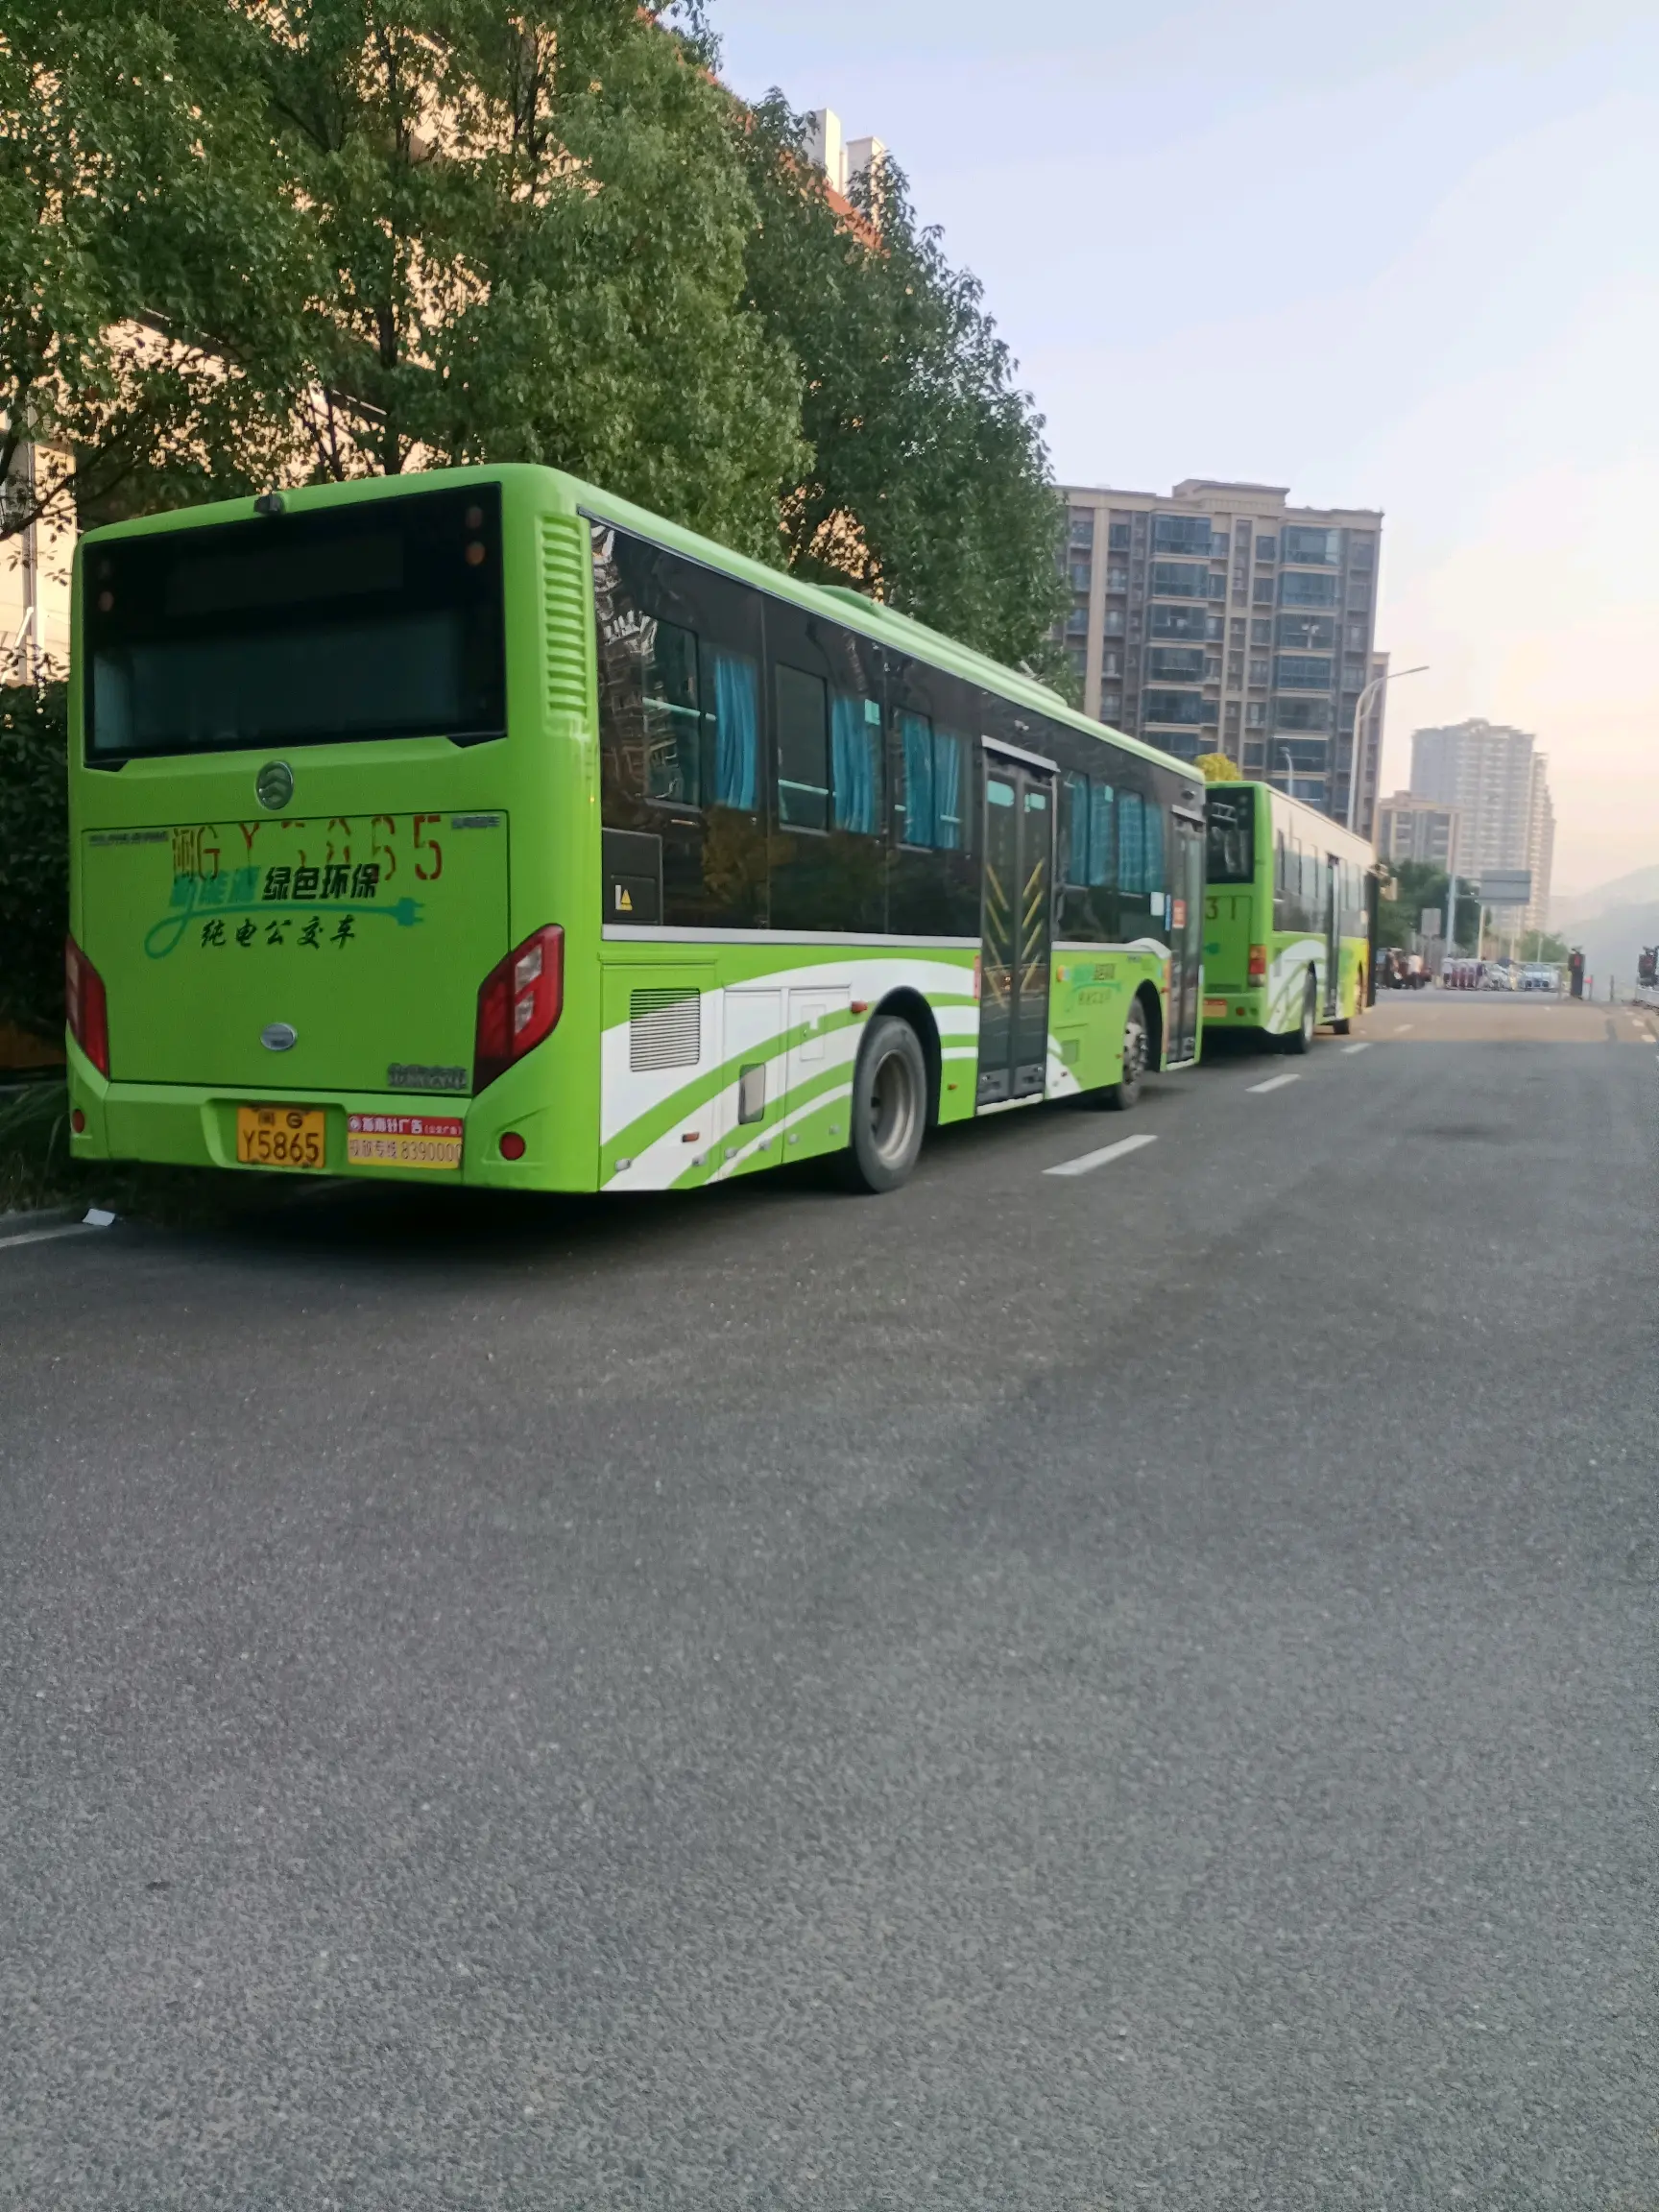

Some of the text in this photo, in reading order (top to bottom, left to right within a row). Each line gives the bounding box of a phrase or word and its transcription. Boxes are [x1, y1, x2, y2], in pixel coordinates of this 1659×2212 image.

[261, 863, 380, 901] 绿色环保
[200, 915, 356, 950] 纯电公交车
[242, 1129, 320, 1164] Y5865
